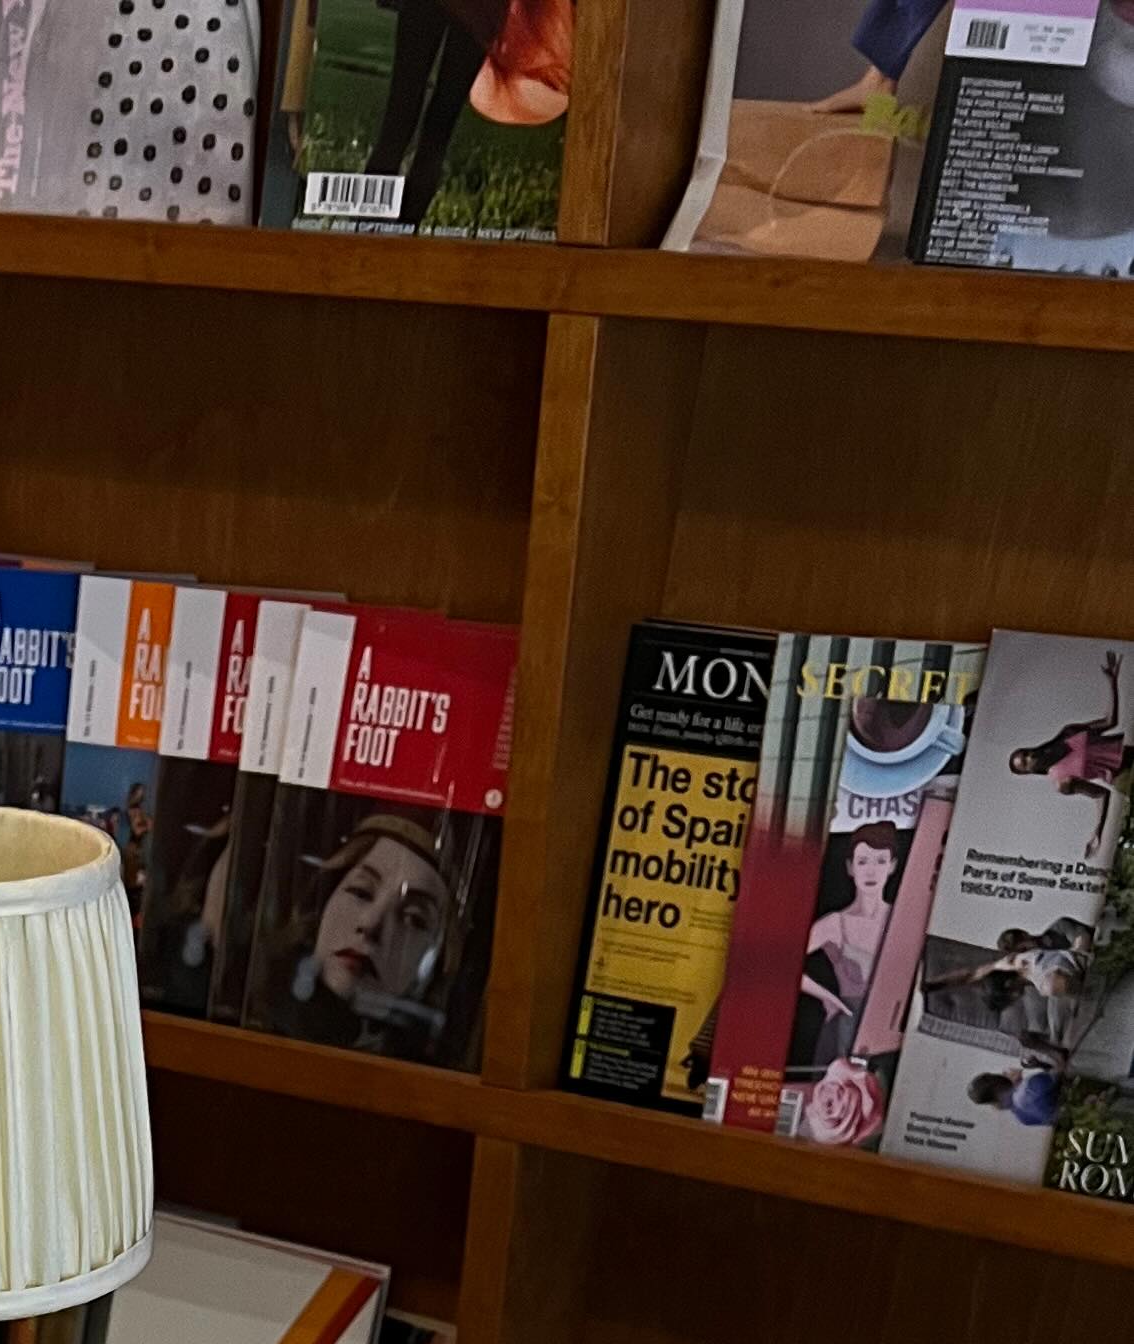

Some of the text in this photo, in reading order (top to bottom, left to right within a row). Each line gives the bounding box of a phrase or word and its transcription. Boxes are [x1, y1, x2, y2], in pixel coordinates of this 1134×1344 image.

[137, 608, 152, 641] A
[231, 620, 245, 653] A
[357, 646, 373, 681] A
[350, 682, 452, 734] RABBIT'S
[343, 724, 401, 769] FOOT
[629, 752, 692, 795] The
[618, 800, 747, 849] of Spai
[609, 849, 741, 902] mobility
[966, 848, 1063, 875] Remembering
[1018, 872, 1058, 888] Some
[602, 882, 681, 929] hero
